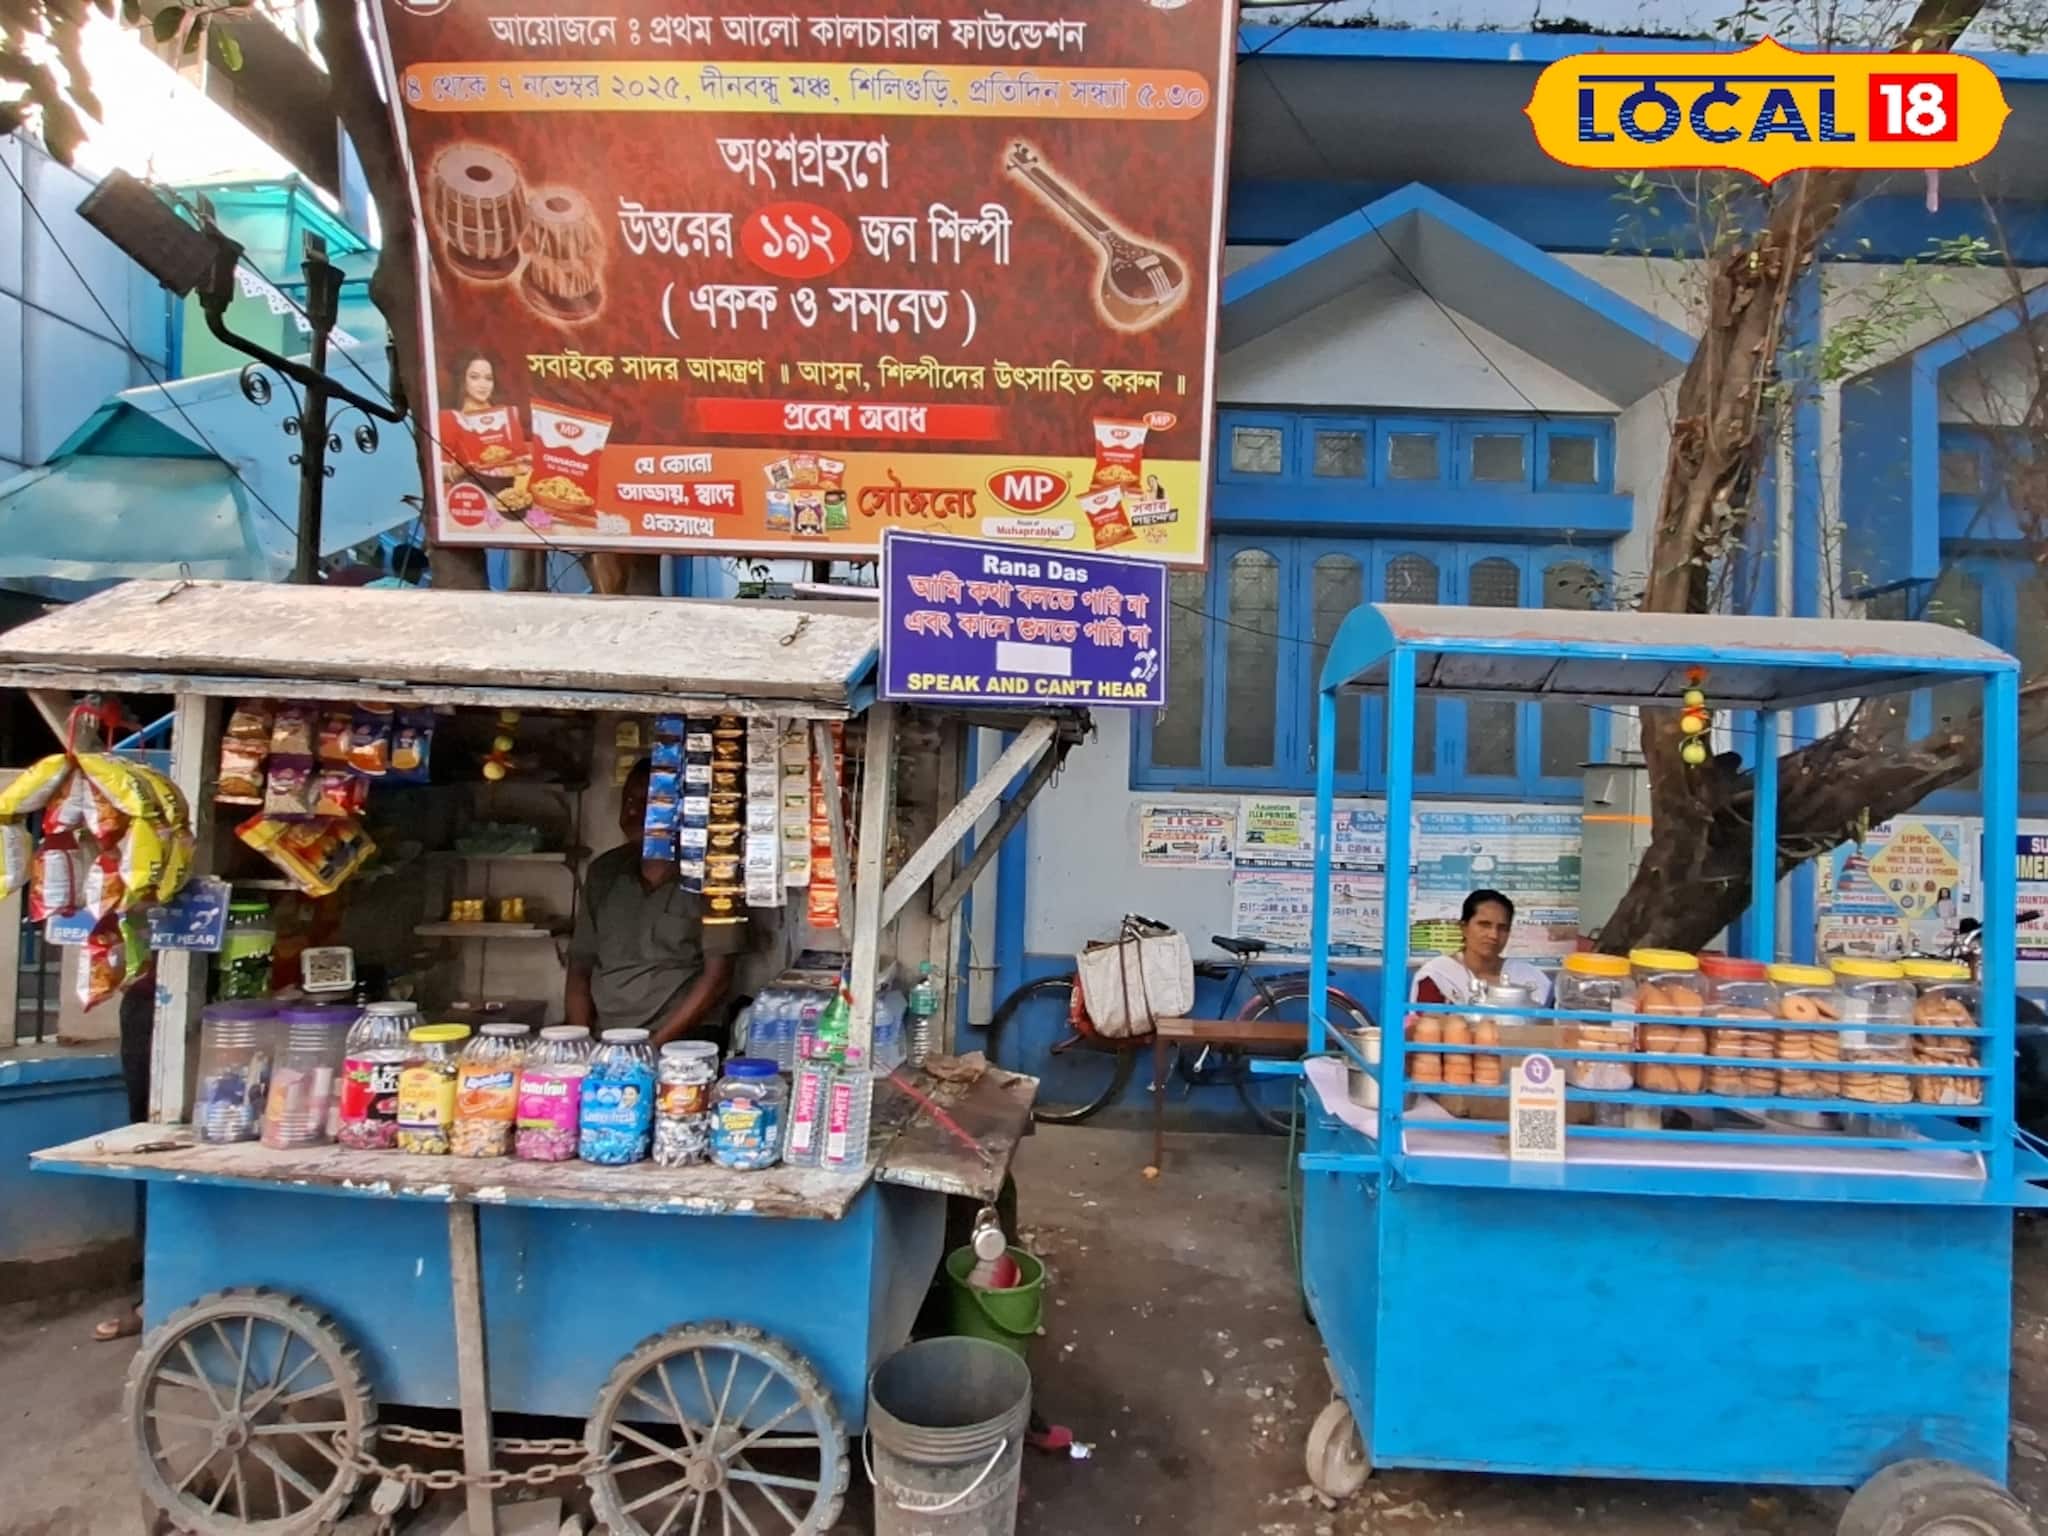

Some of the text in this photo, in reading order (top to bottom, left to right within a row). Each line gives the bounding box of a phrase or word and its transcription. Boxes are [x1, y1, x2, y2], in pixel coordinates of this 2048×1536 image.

[489, 15, 616, 47] আয়োজনে
[650, 15, 712, 47] প্রথম
[722, 15, 798, 48] আলো
[810, 14, 940, 49] কালচারাল
[951, 10, 1087, 52] ফাউন্ডেশন
[405, 64, 1205, 109] ৪ থেকে ৭ নভেম্বর ২০২৫, দীনবন্ধু মঞ্চ, শিলিগুড়ি, প্রতিদিন সন্ধ্যা ৫.৩০
[716, 133, 889, 190] অংশগ্রহণে
[617, 196, 1013, 266] উত্তরের ১৯২ জন শিল্পী
[689, 283, 779, 329] একক
[790, 287, 818, 329] ও
[828, 287, 949, 336] সমবেত
[527, 348, 614, 380] সবাইকে
[620, 356, 680, 383] সাদর
[687, 358, 765, 385] আমন্ত্রণ
[797, 359, 871, 394] আসুন,
[878, 354, 986, 391] শিল্পীদের
[993, 357, 1095, 395] উৎসাহিত
[1102, 366, 1163, 396] করুন
[782, 400, 929, 434] প্রবেশ অবাধ
[1150, 411, 1171, 427] MP
[634, 452, 713, 475] যে কোনো
[693, 484, 735, 507] স্বাদে
[856, 467, 977, 520] সৌজন্যে
[1003, 473, 1055, 503] MP
[641, 513, 715, 537] একসাথে
[982, 553, 1089, 583] Rana Das
[907, 569, 1150, 619] আমি কথা বলতে পারি না
[903, 608, 1152, 649] এবং কানে শুনতে পারি না
[906, 672, 1148, 700] SPEAK AND CAN'T HEAR
[177, 933, 216, 945] HEAR
